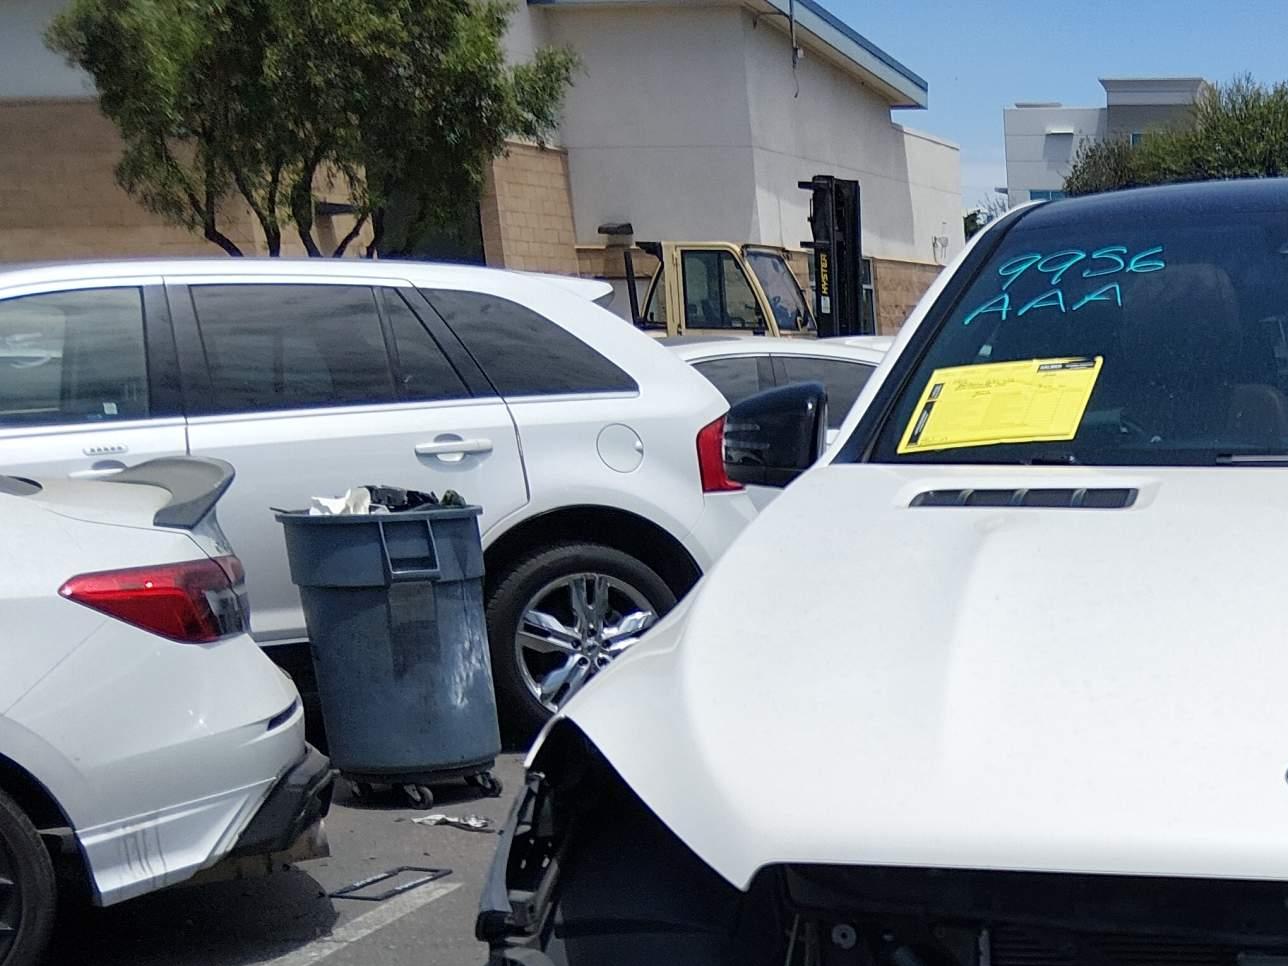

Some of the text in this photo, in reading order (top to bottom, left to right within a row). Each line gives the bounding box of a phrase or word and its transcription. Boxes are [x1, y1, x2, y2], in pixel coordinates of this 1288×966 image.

[820, 253, 829, 295] HYSTER
[998, 246, 1166, 291] 9956
[963, 282, 1123, 326] AAA
